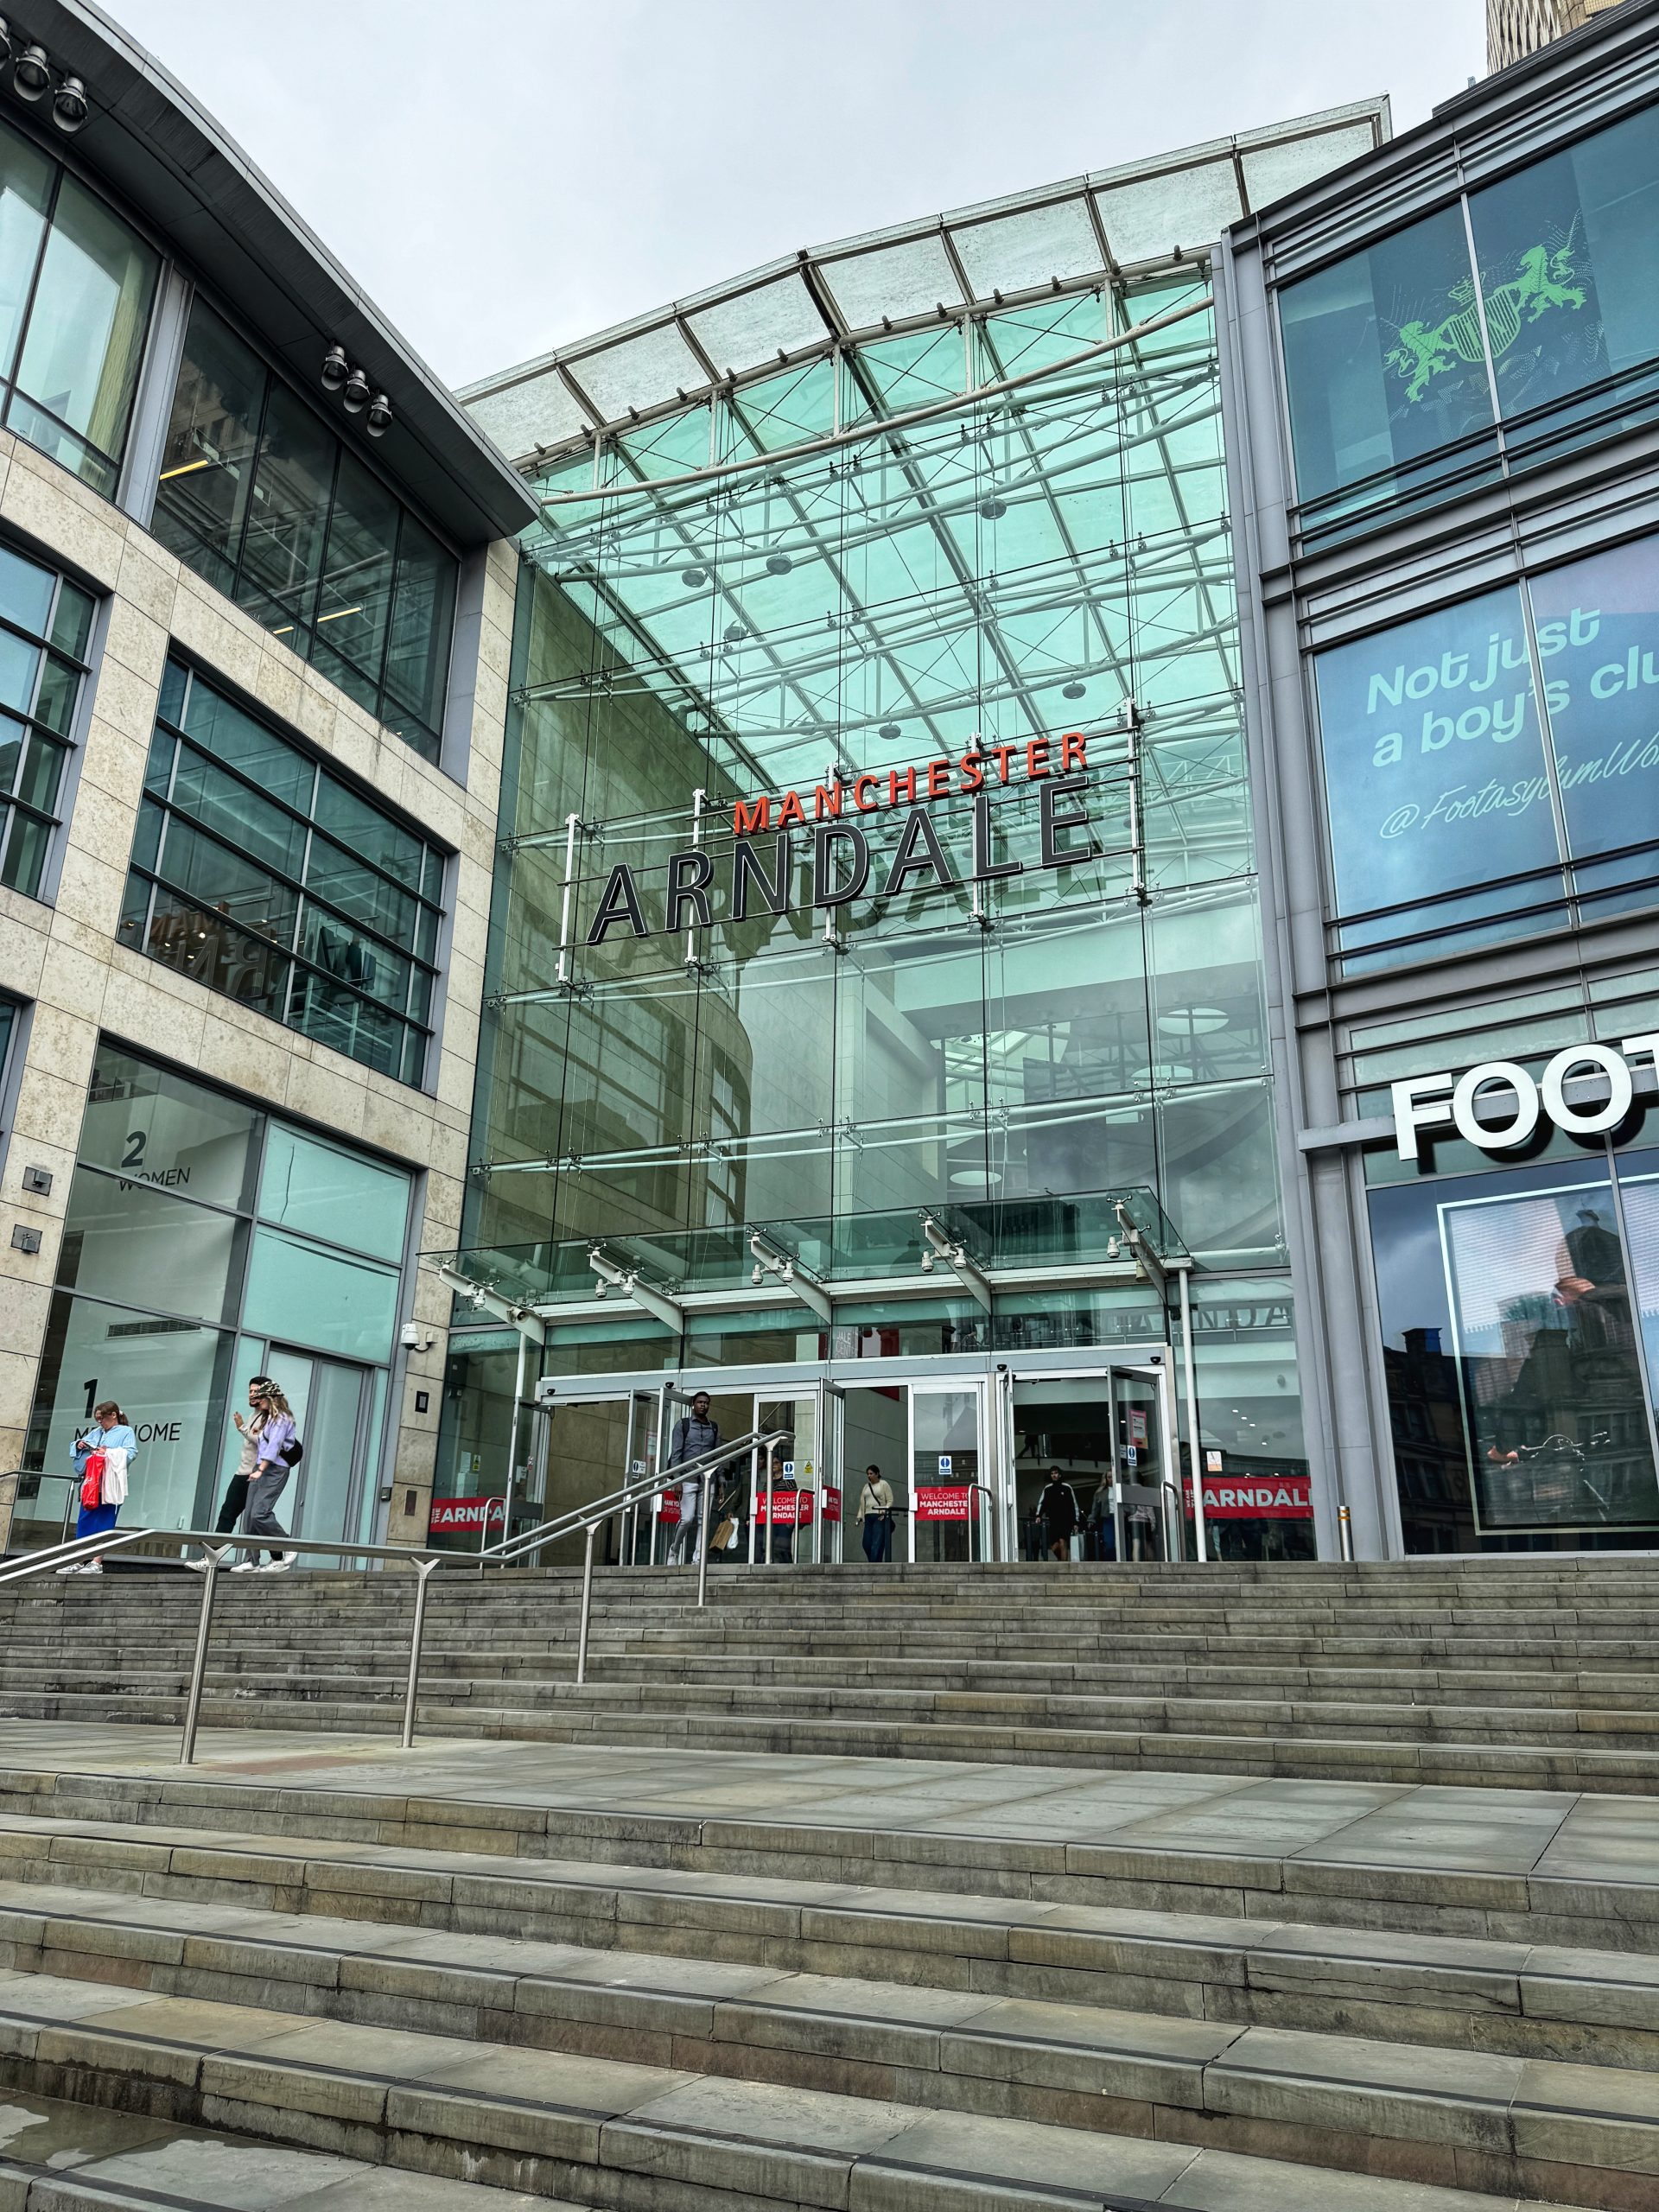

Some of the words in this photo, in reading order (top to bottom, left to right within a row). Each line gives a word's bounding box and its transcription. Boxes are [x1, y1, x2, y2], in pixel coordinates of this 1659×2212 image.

[1367, 652, 1468, 715] Not
[1470, 607, 1600, 692] just
[1372, 732, 1403, 767] a
[1421, 678, 1570, 754] boy's
[734, 732, 1088, 836] MANCHESTER
[587, 776, 1091, 945] ARNDALE
[121, 1130, 146, 1168] 2
[119, 1167, 191, 1192] WOMEN
[84, 1378, 99, 1419] 1
[760, 1503, 810, 1512] MNCHESER
[1203, 1487, 1313, 1507] ARNDAL
